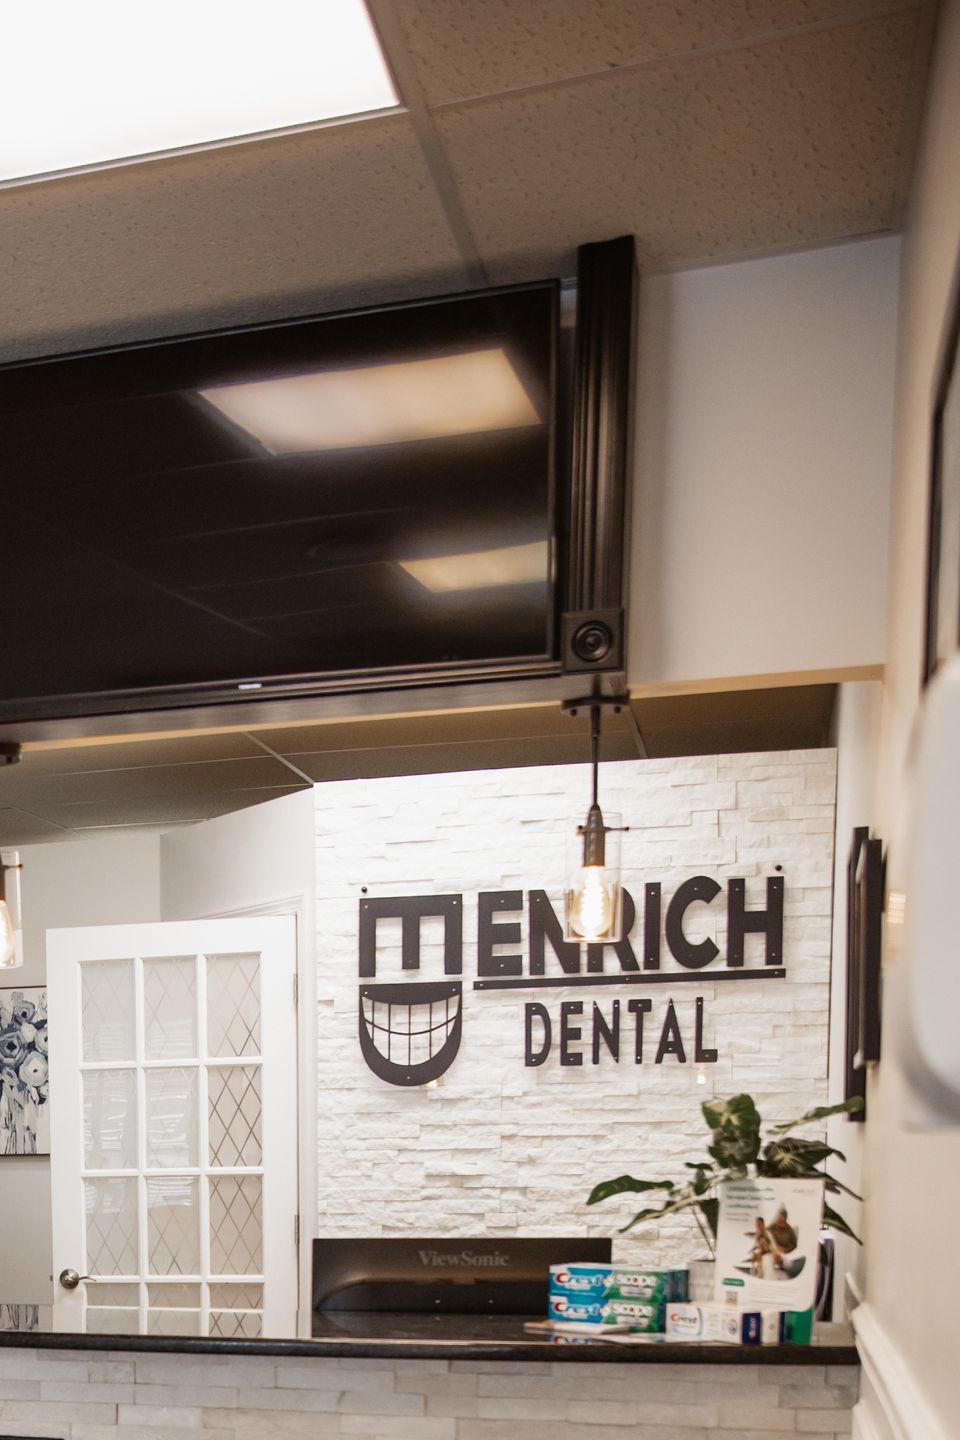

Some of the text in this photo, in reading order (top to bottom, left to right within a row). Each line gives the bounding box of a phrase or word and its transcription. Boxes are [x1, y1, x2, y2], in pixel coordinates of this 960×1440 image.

[477, 875, 785, 977] ENRICH
[524, 996, 719, 1068] DENTAL
[417, 1249, 510, 1267] ViewSonic
